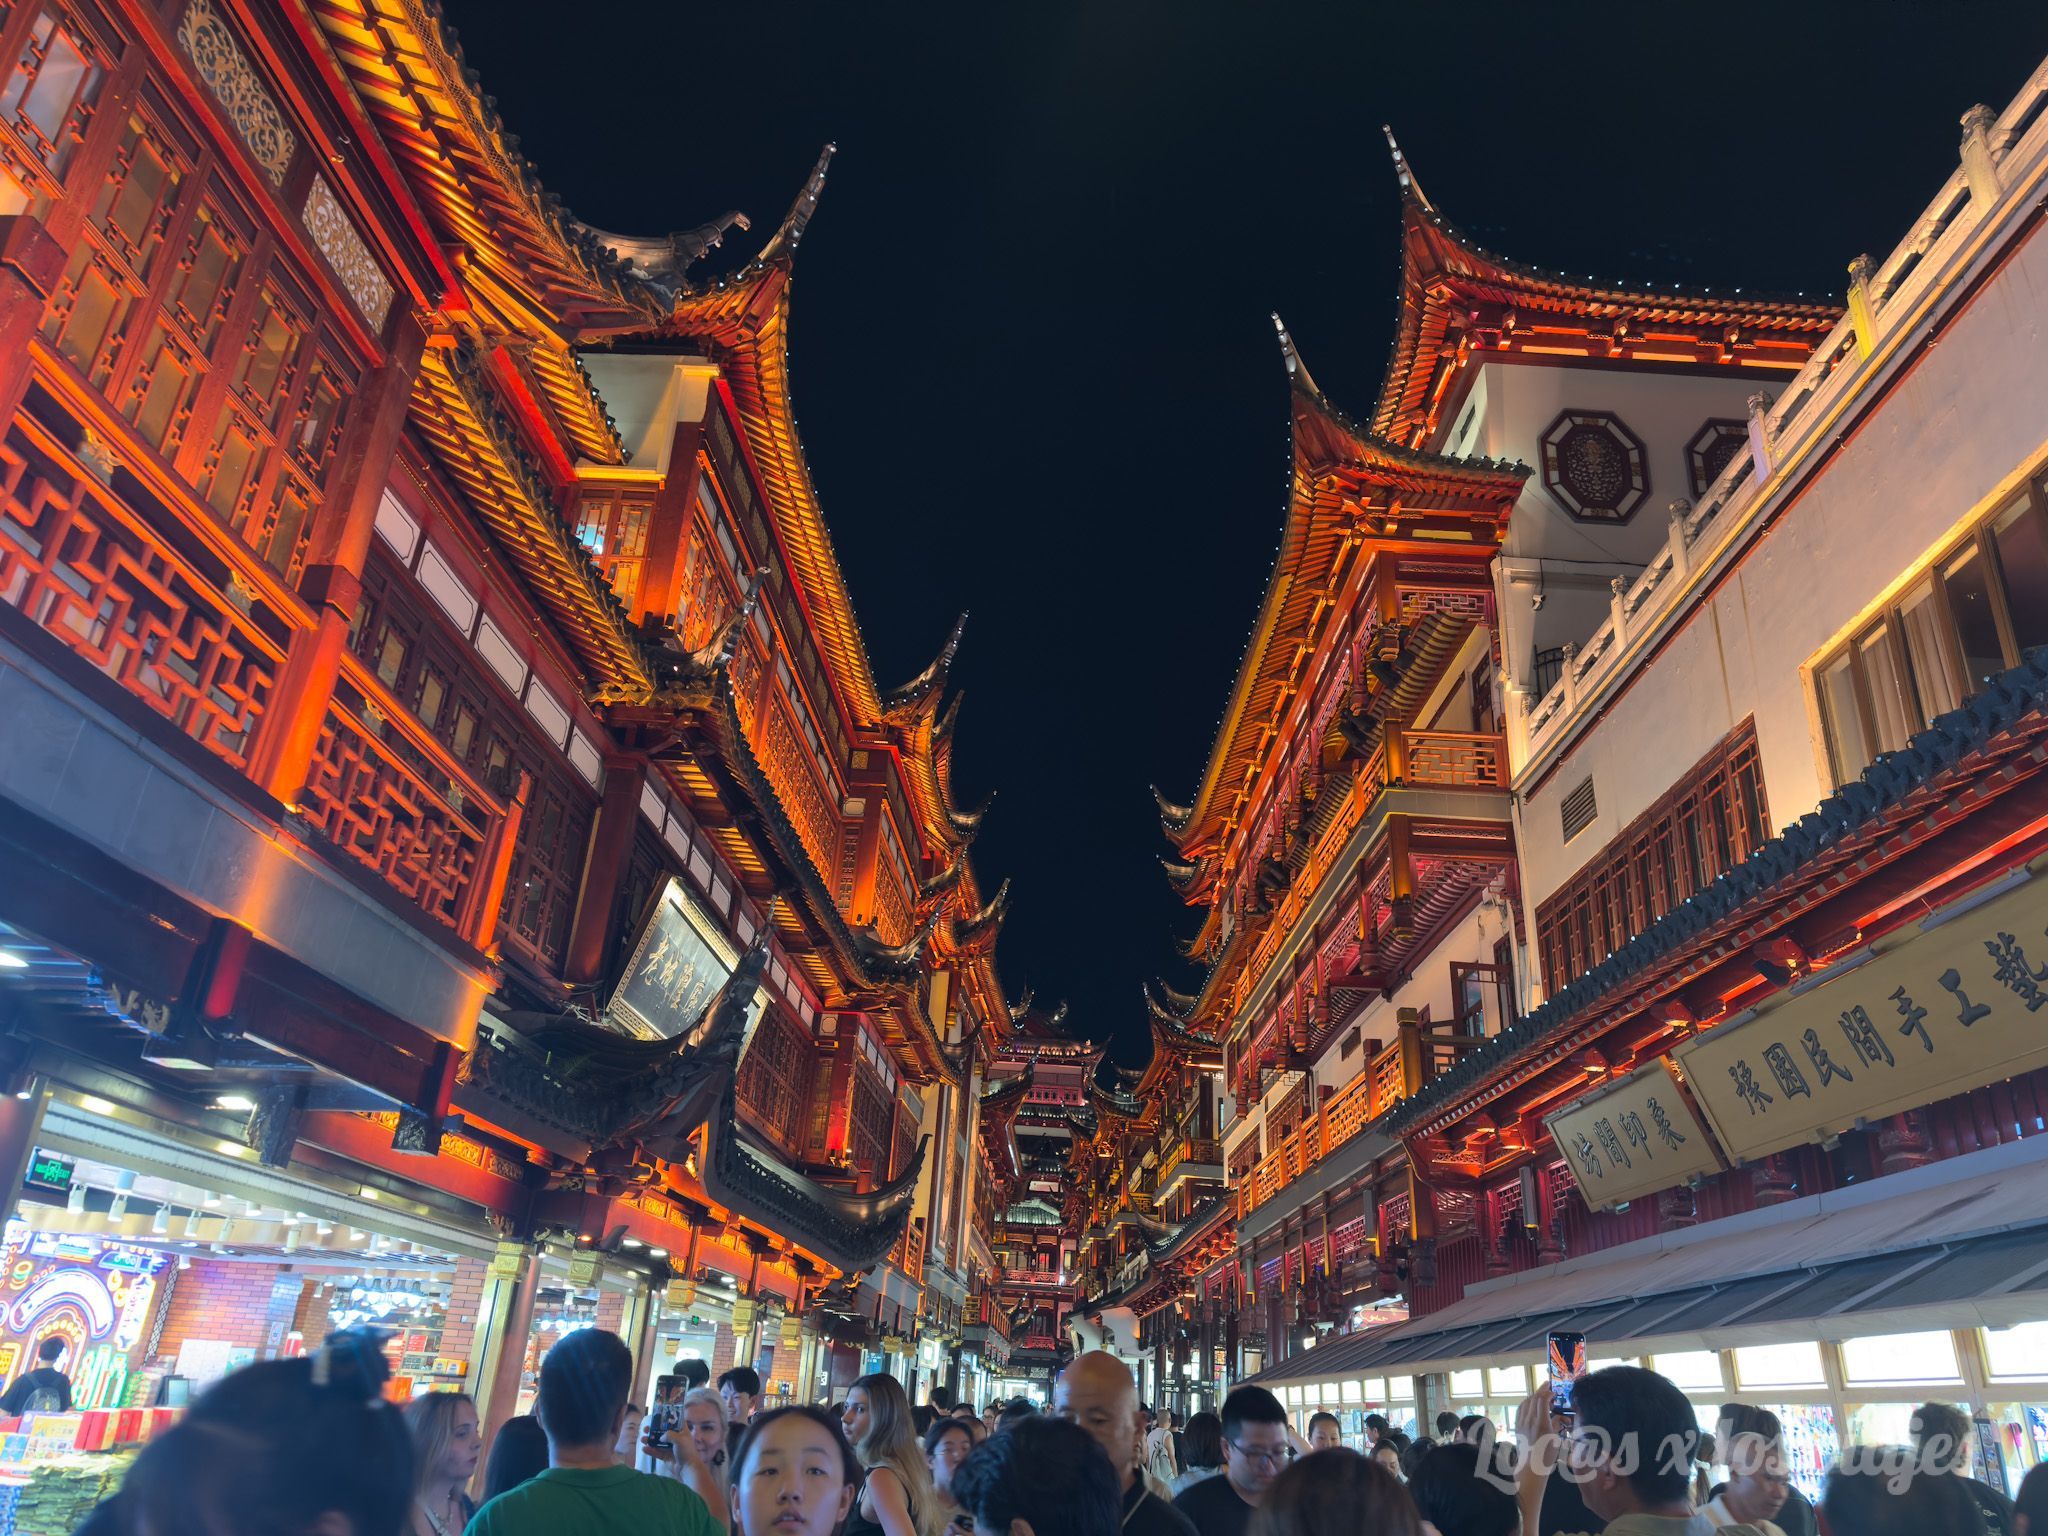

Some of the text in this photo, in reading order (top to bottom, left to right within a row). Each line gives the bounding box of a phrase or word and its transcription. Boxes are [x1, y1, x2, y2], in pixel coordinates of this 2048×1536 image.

[1728, 925, 2048, 1115] 豫園民間手工藝
